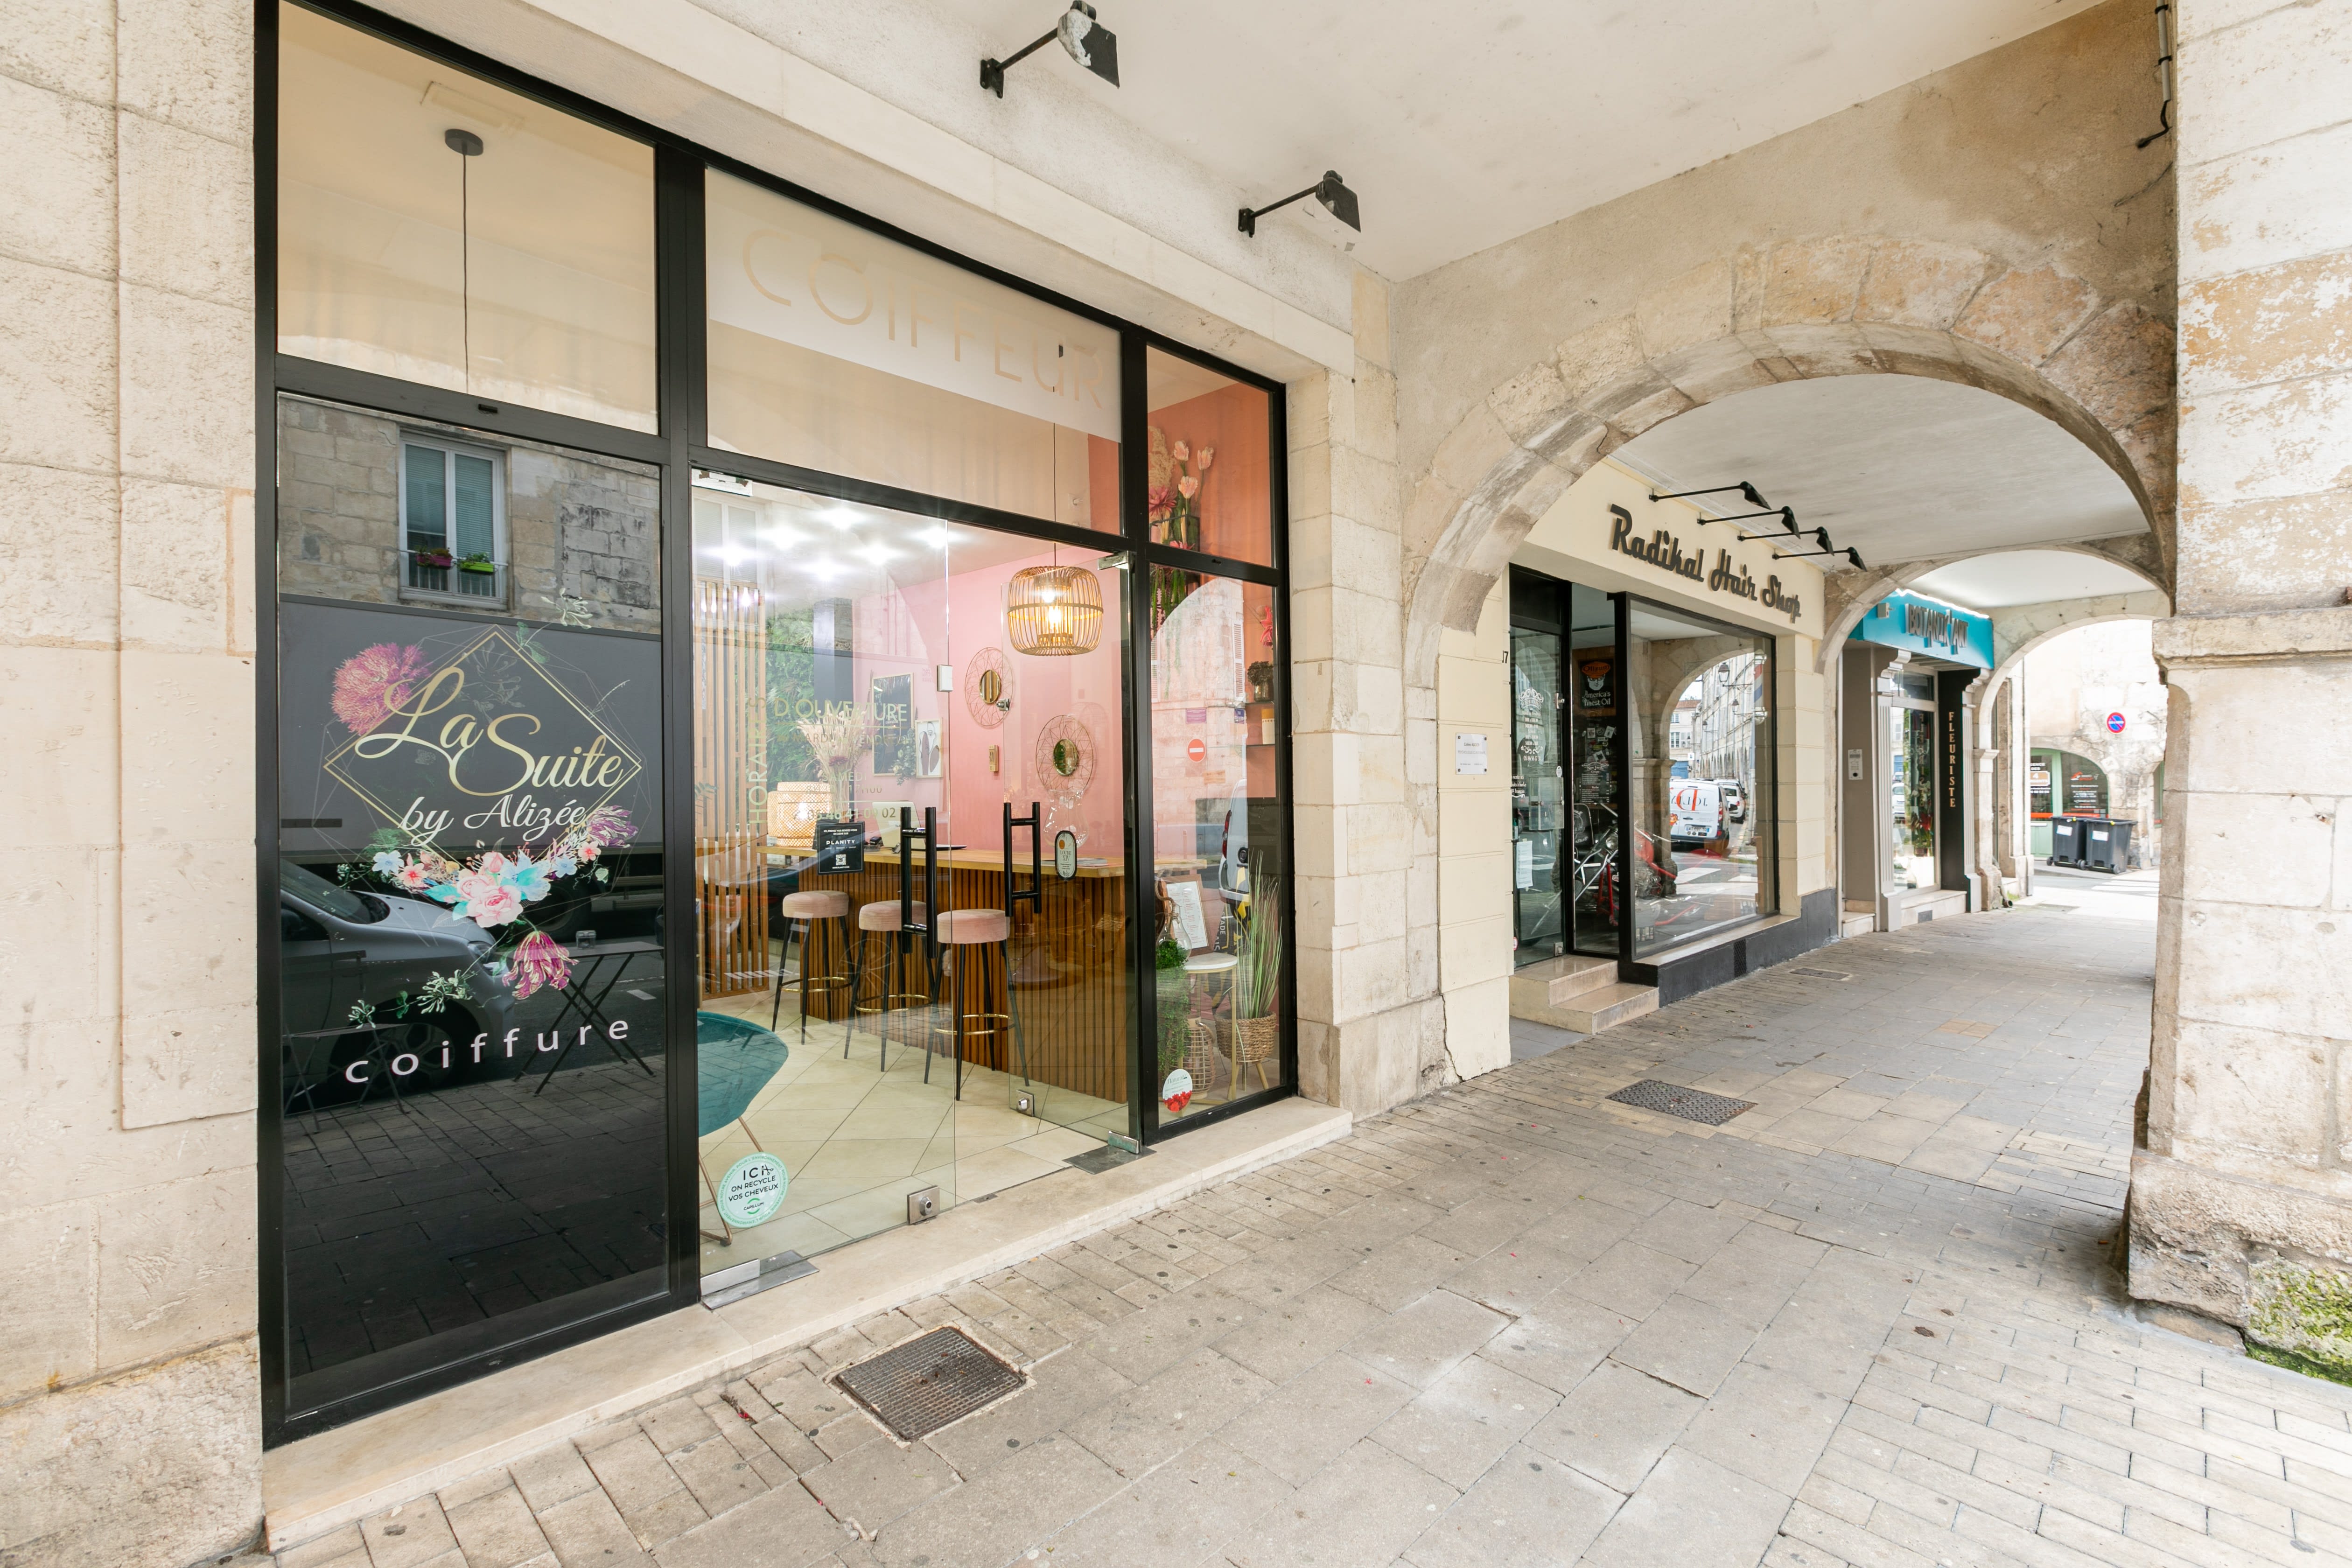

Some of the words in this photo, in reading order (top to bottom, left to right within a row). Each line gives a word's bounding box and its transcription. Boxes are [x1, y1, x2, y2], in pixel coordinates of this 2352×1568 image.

[742, 228, 1103, 409] COIFFEUR
[1610, 504, 1704, 582] Radikal
[1711, 548, 1758, 601] Hair
[1763, 574, 1802, 624] Shop
[1502, 650, 1509, 663] 17
[355, 666, 483, 759] La
[448, 713, 624, 797] Suite
[748, 697, 768, 824] HORAIRES
[822, 771, 867, 782] SAMEDI
[397, 796, 455, 847] by
[463, 794, 587, 842] Alizée
[824, 809, 840, 820] 46
[845, 808, 859, 819] 41
[882, 807, 896, 818] 02
[345, 1019, 628, 1084] coiffure
[728, 1193, 743, 1202] VOS
[744, 1183, 778, 1197] CHEVEUX
[744, 1175, 776, 1189] RECYCLE
[743, 1202, 764, 1211] CAPILLUM
